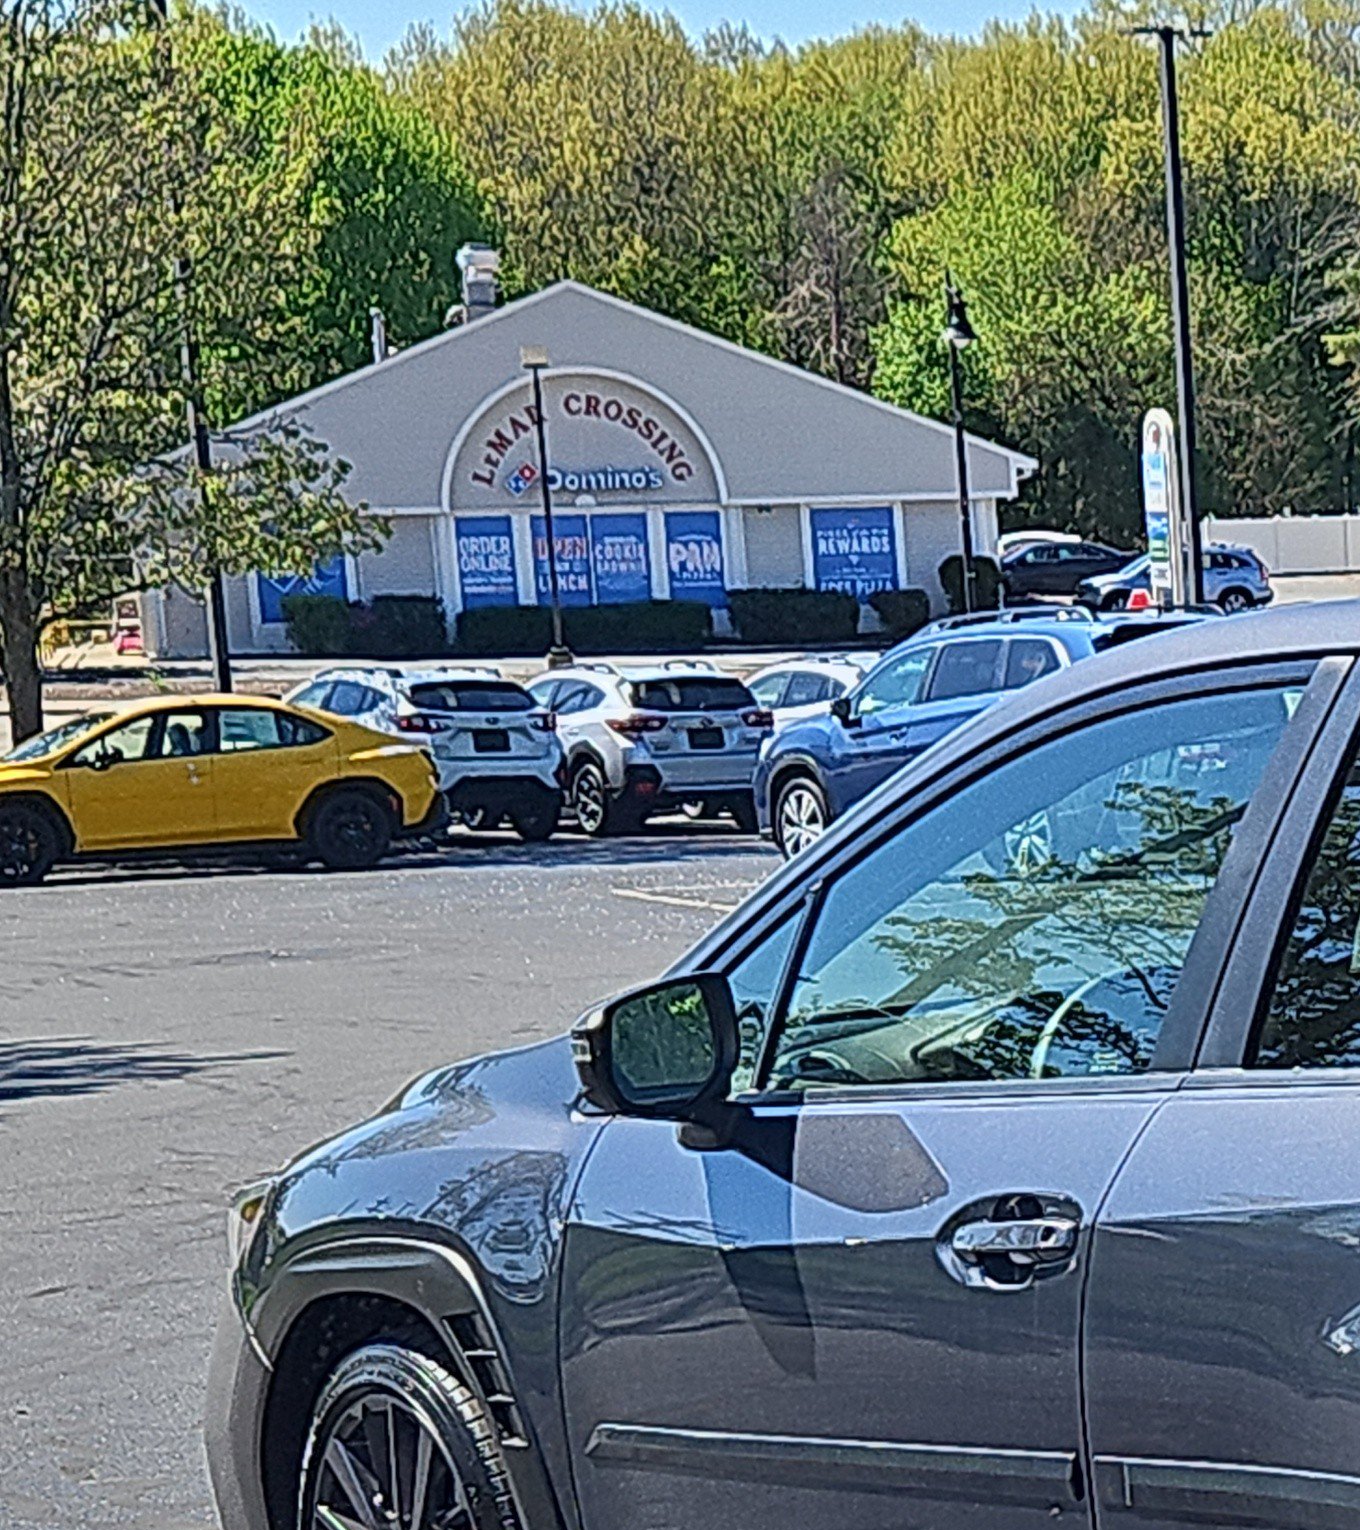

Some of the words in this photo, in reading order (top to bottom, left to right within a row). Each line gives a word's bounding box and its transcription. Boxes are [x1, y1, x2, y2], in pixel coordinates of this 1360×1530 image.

[563, 393, 694, 482] CROSSING
[547, 464, 663, 491] Domino's
[459, 536, 511, 554] ORDER
[817, 536, 891, 555] REWARDS
[460, 555, 513, 573] ONLINE
[669, 541, 721, 573] PAN
